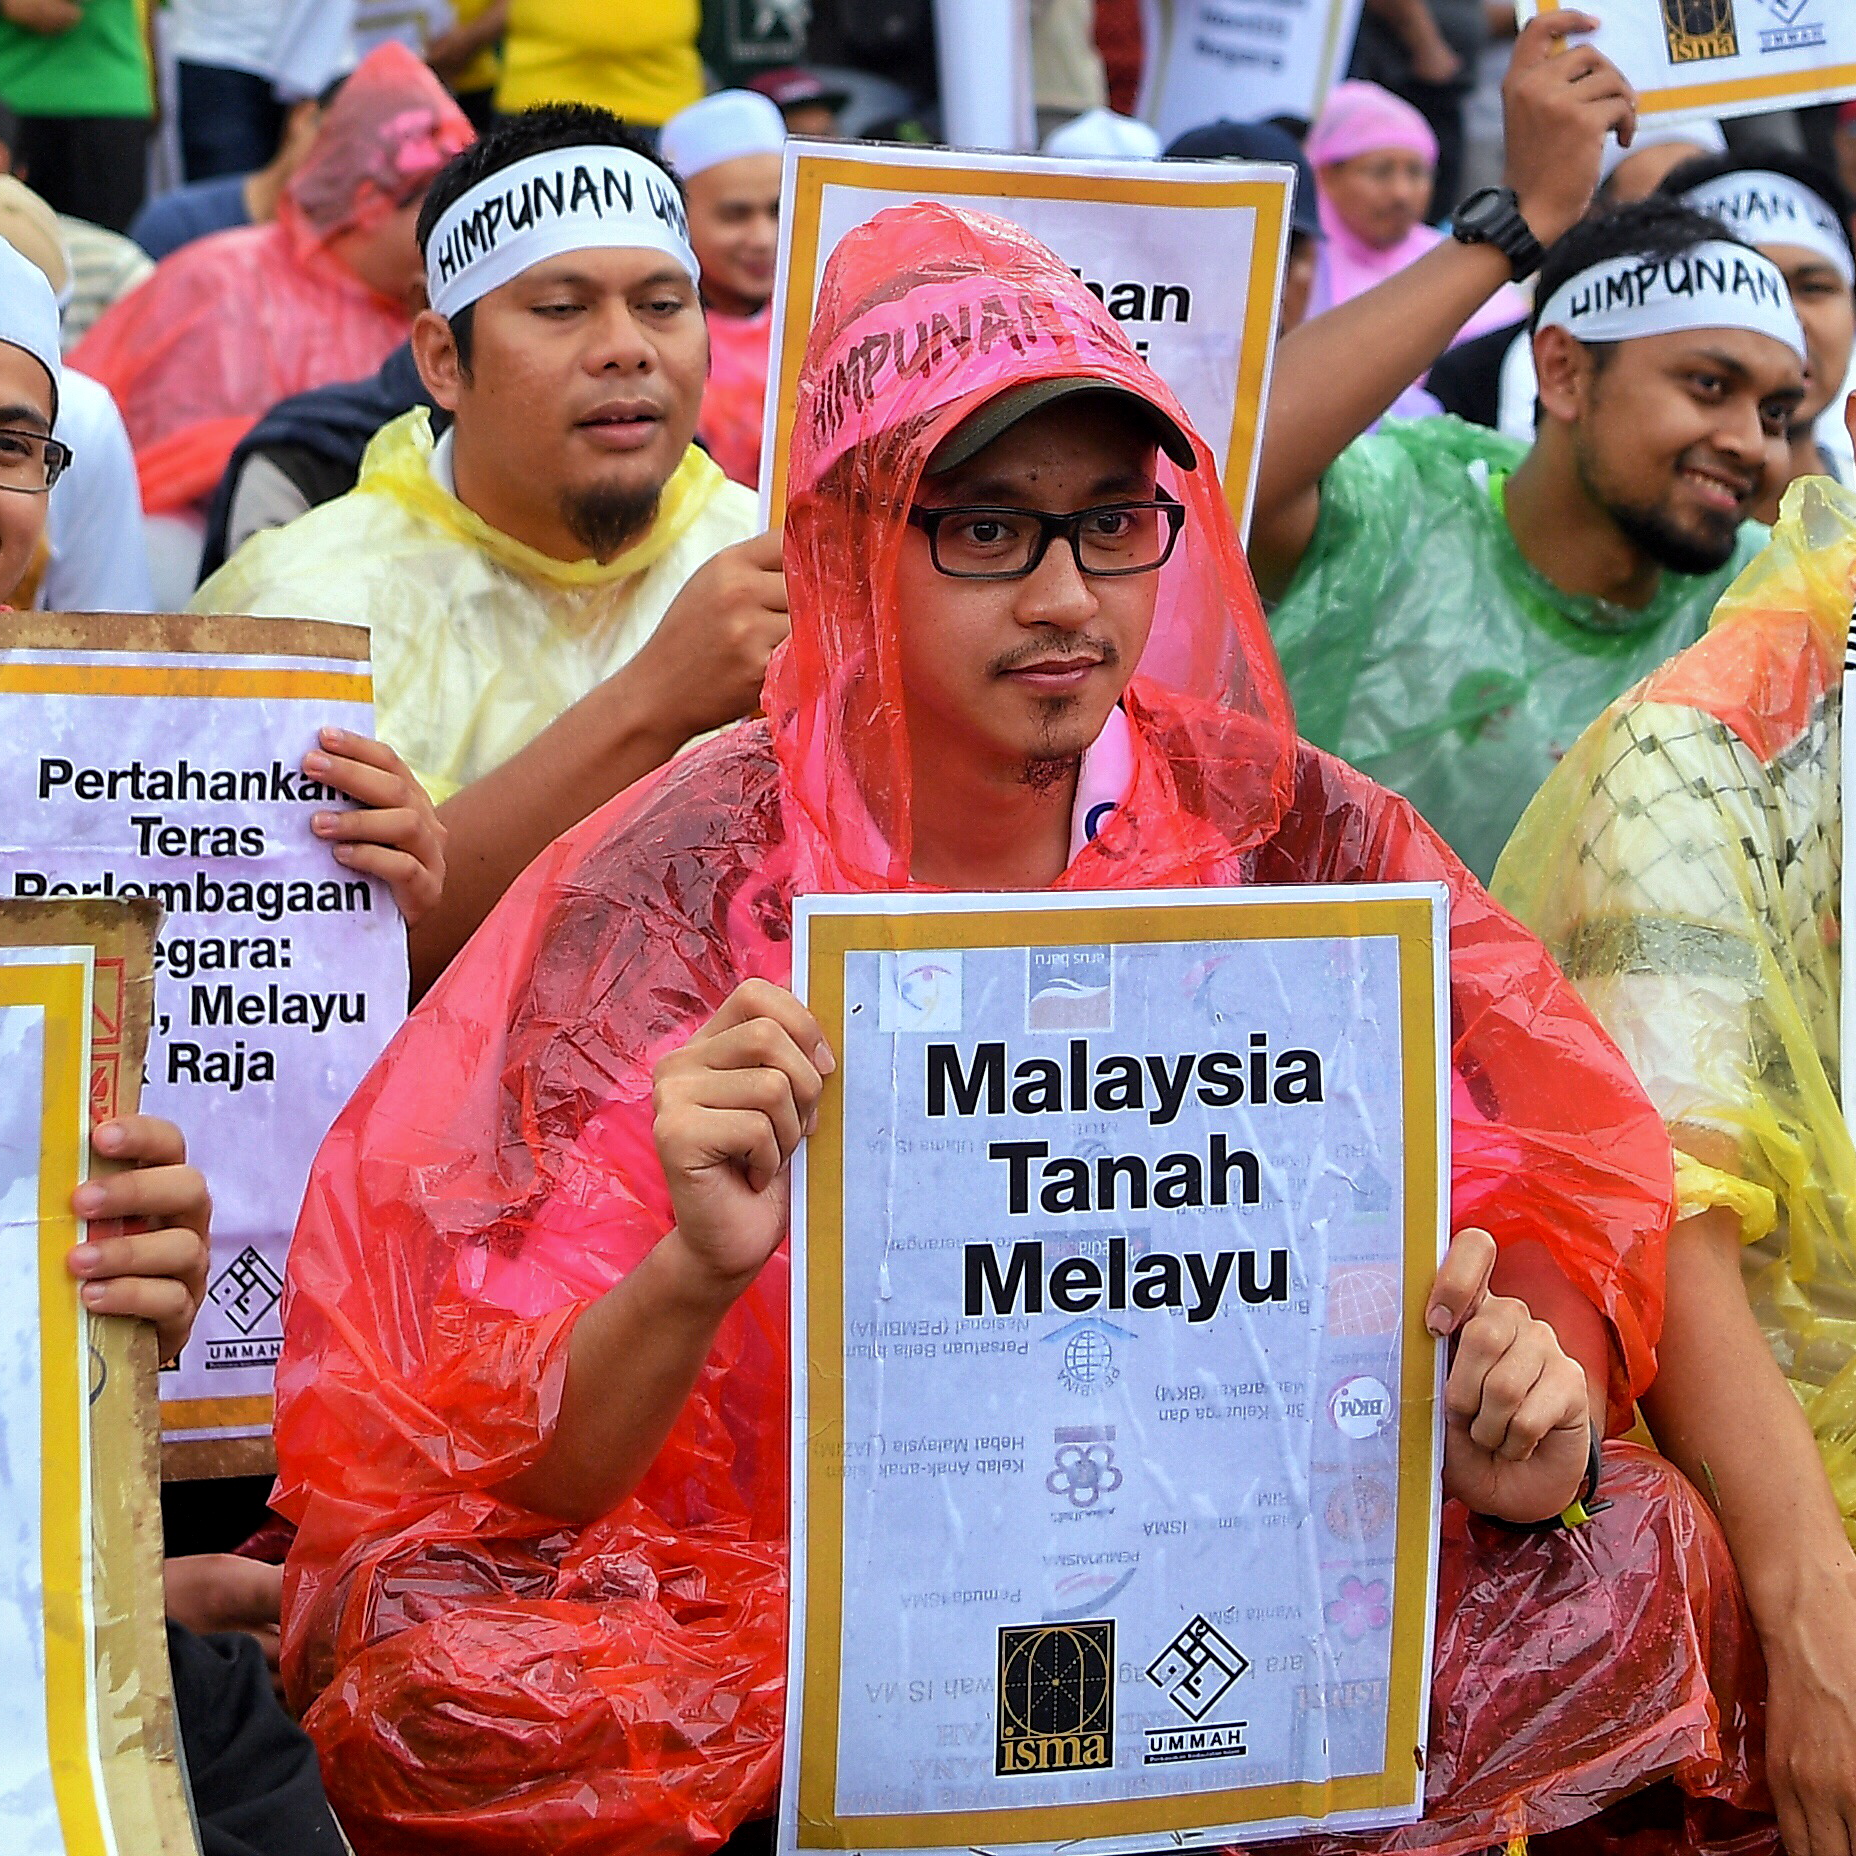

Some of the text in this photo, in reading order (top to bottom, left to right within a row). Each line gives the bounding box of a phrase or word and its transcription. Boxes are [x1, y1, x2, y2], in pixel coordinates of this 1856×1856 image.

[1669, 34, 1737, 63] isma
[438, 164, 634, 284] HIMPUNAN
[130, 815, 266, 858] Teras
[191, 984, 365, 1033] Melayu
[168, 1040, 275, 1092] Raja
[927, 1032, 1323, 1125] Malaysia
[989, 1134, 1260, 1214] Tanah
[964, 1238, 1289, 1322] Melayu
[210, 1344, 281, 1360] UMMAH
[1341, 1398, 1384, 1417] BKM
[1001, 1733, 1110, 1772] isma
[1150, 1730, 1241, 1752] UMMAH
